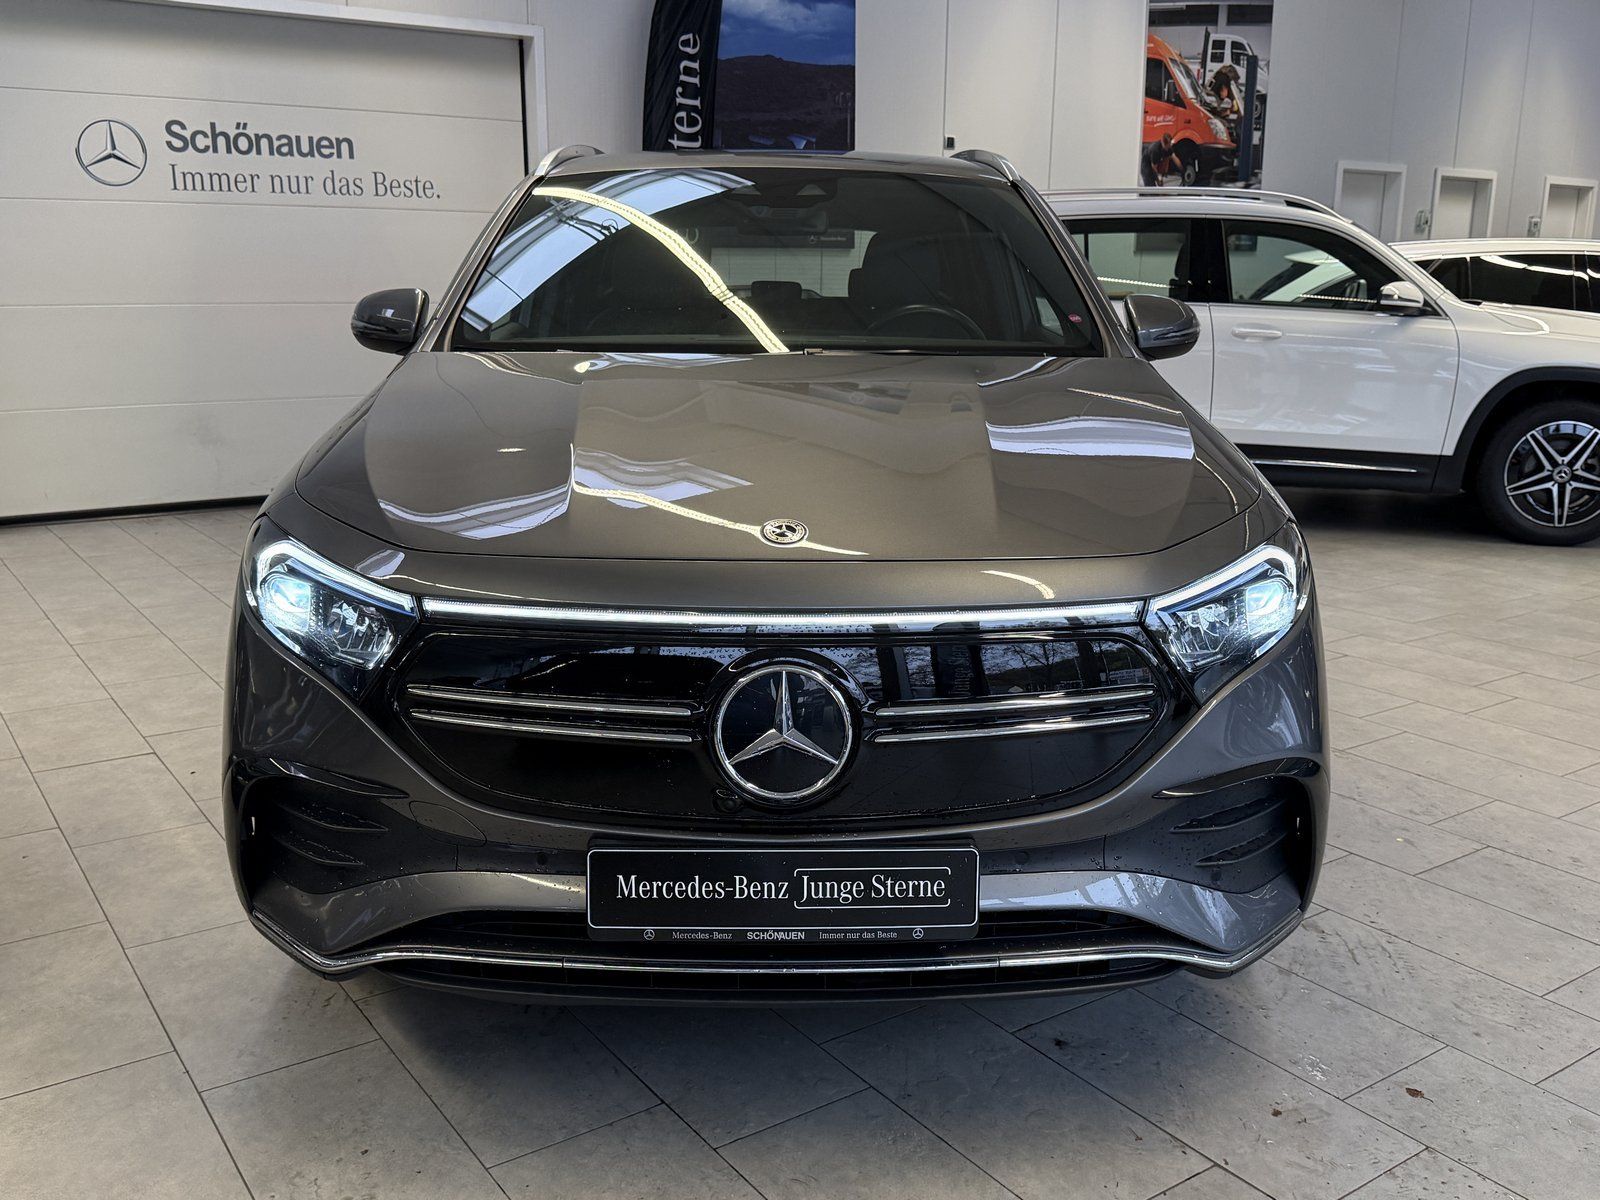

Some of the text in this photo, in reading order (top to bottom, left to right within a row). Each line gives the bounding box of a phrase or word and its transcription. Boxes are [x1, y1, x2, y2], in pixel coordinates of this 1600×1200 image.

[668, 33, 702, 150] terne
[165, 119, 355, 160] Schönauen
[169, 163, 441, 200] Immer nur das Beste.
[616, 874, 946, 904] Mercedes-Benz Junge Sterne
[671, 930, 898, 941] Mercedes-Benz SCHÖNAUEN Immer nur das Beste
